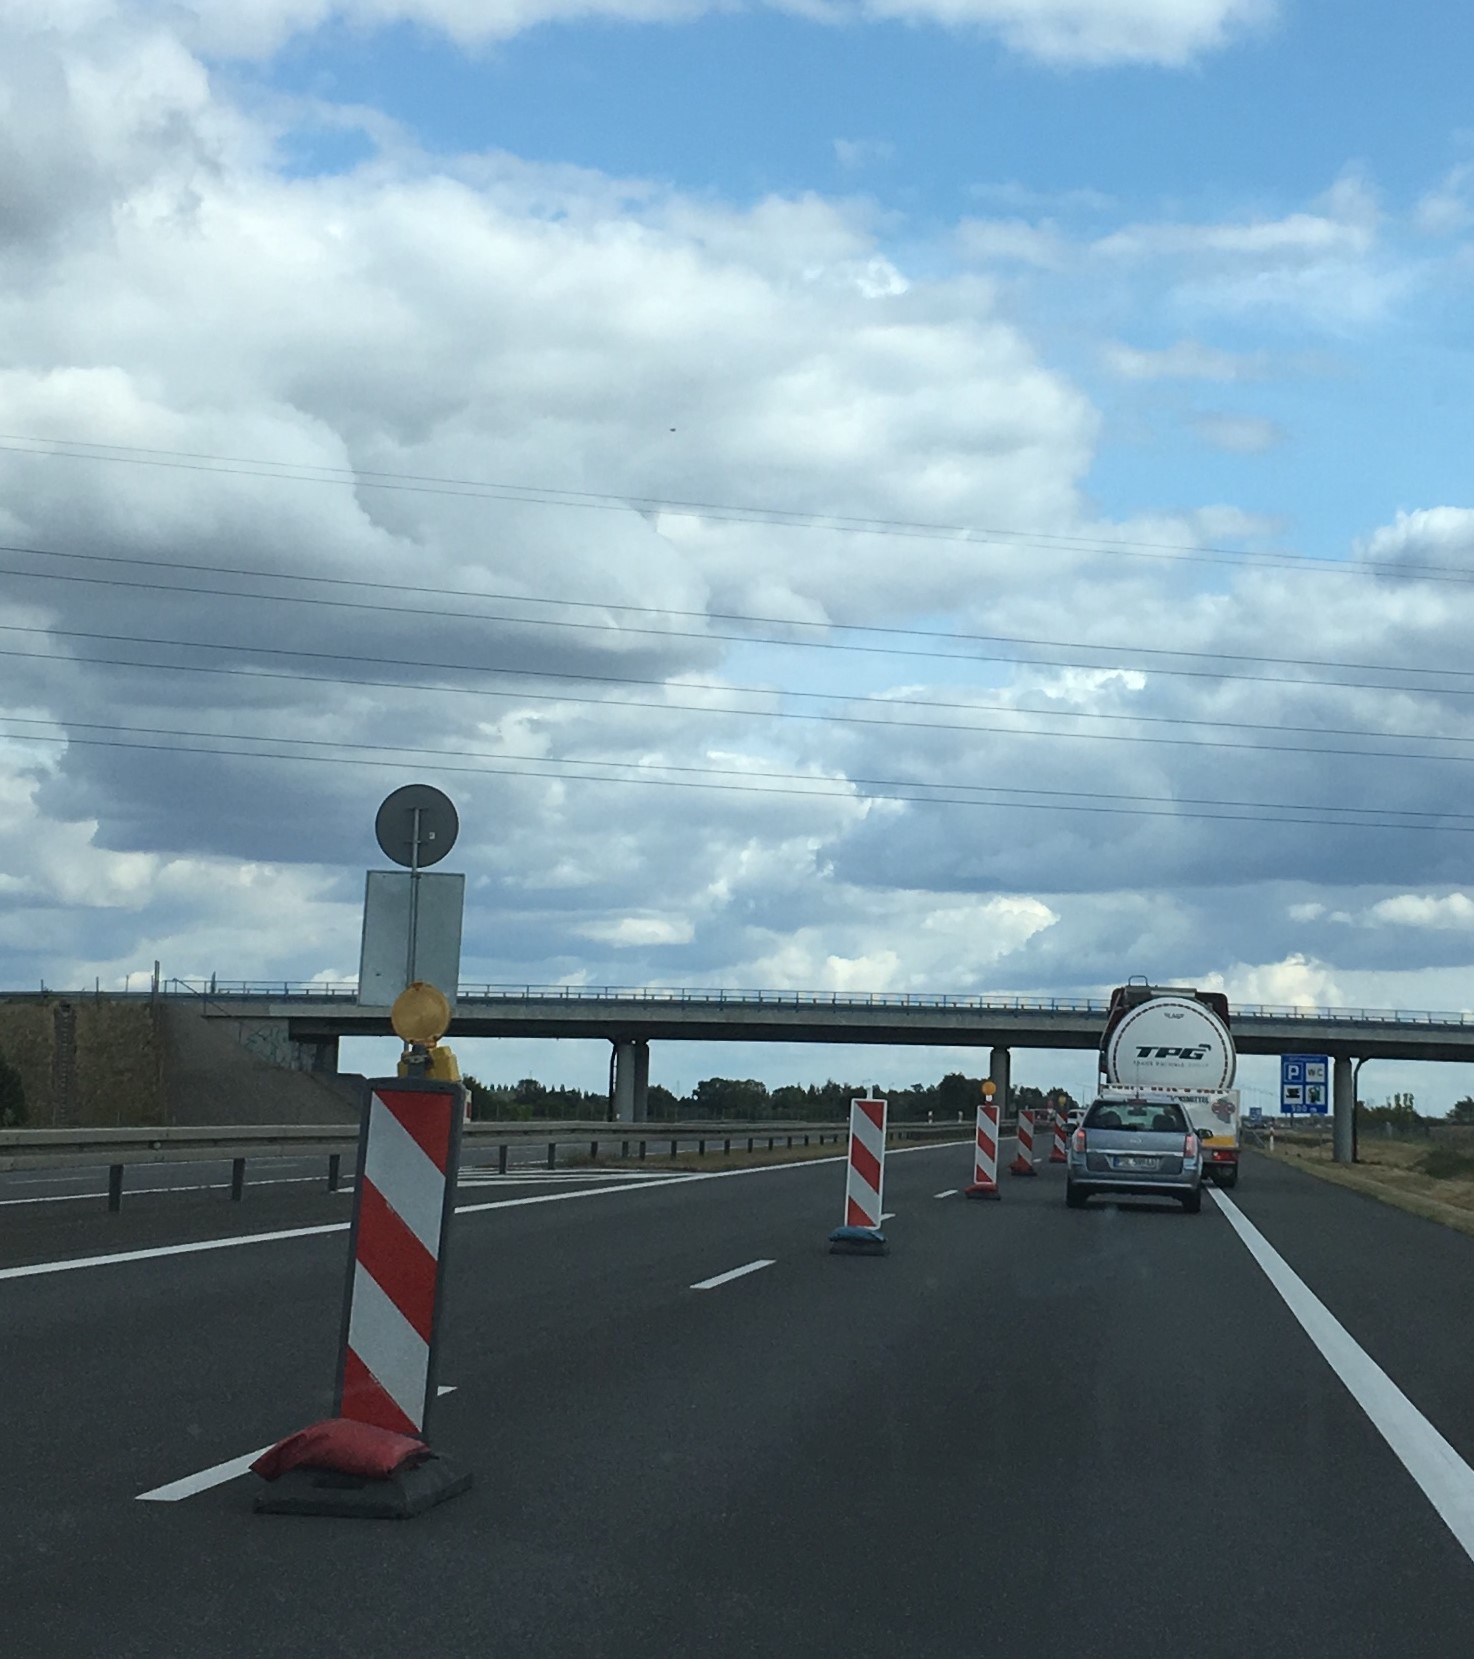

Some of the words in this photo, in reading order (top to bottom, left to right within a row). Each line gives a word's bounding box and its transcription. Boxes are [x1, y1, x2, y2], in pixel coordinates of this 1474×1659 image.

[1135, 1045, 1207, 1061] TPG
[1287, 1064, 1300, 1080] P
[1307, 1068, 1323, 1077] WC
